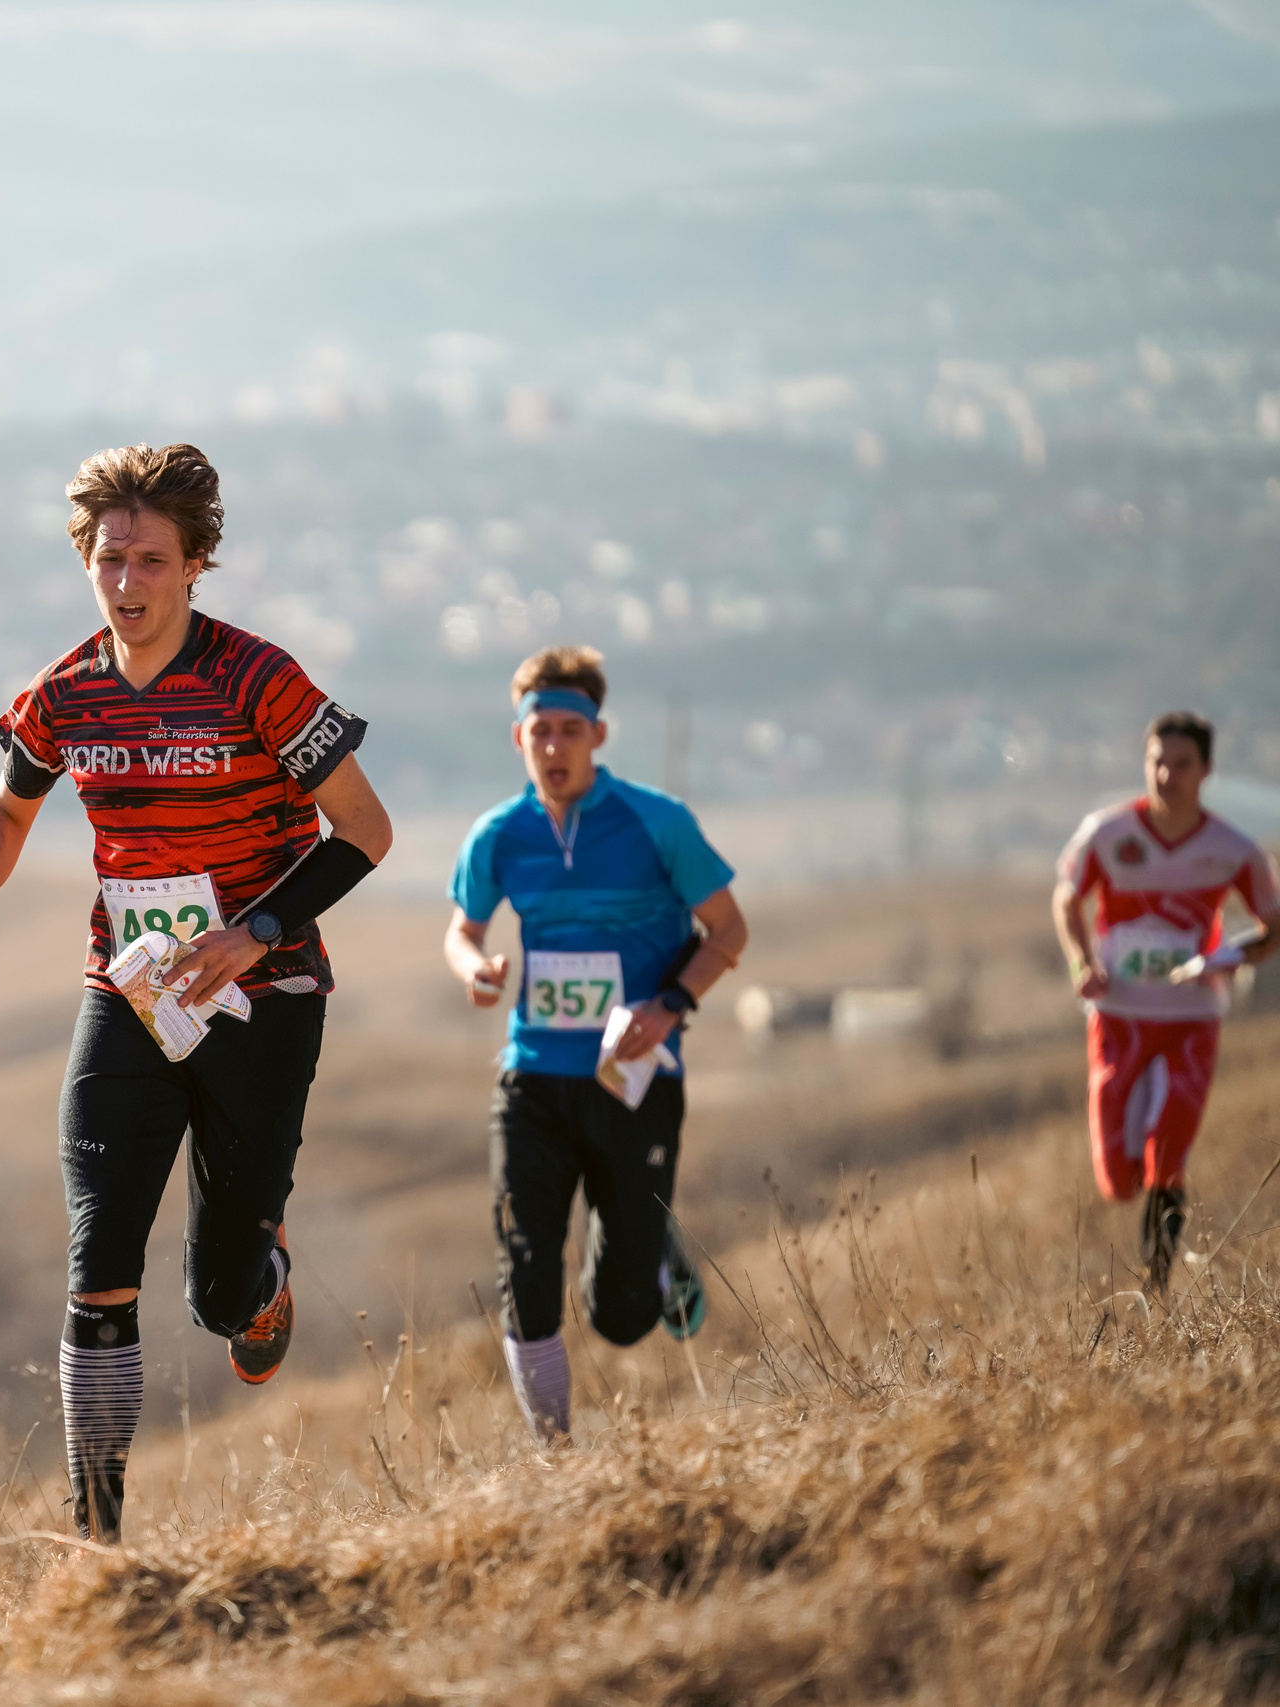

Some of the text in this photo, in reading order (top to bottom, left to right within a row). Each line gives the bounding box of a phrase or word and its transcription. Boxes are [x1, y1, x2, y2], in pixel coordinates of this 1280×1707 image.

[148, 730, 219, 741] Saint-Petersburg
[284, 716, 343, 779] NORD
[60, 745, 238, 775] NORD WEST
[123, 904, 210, 943] 482
[536, 978, 614, 1017] 357
